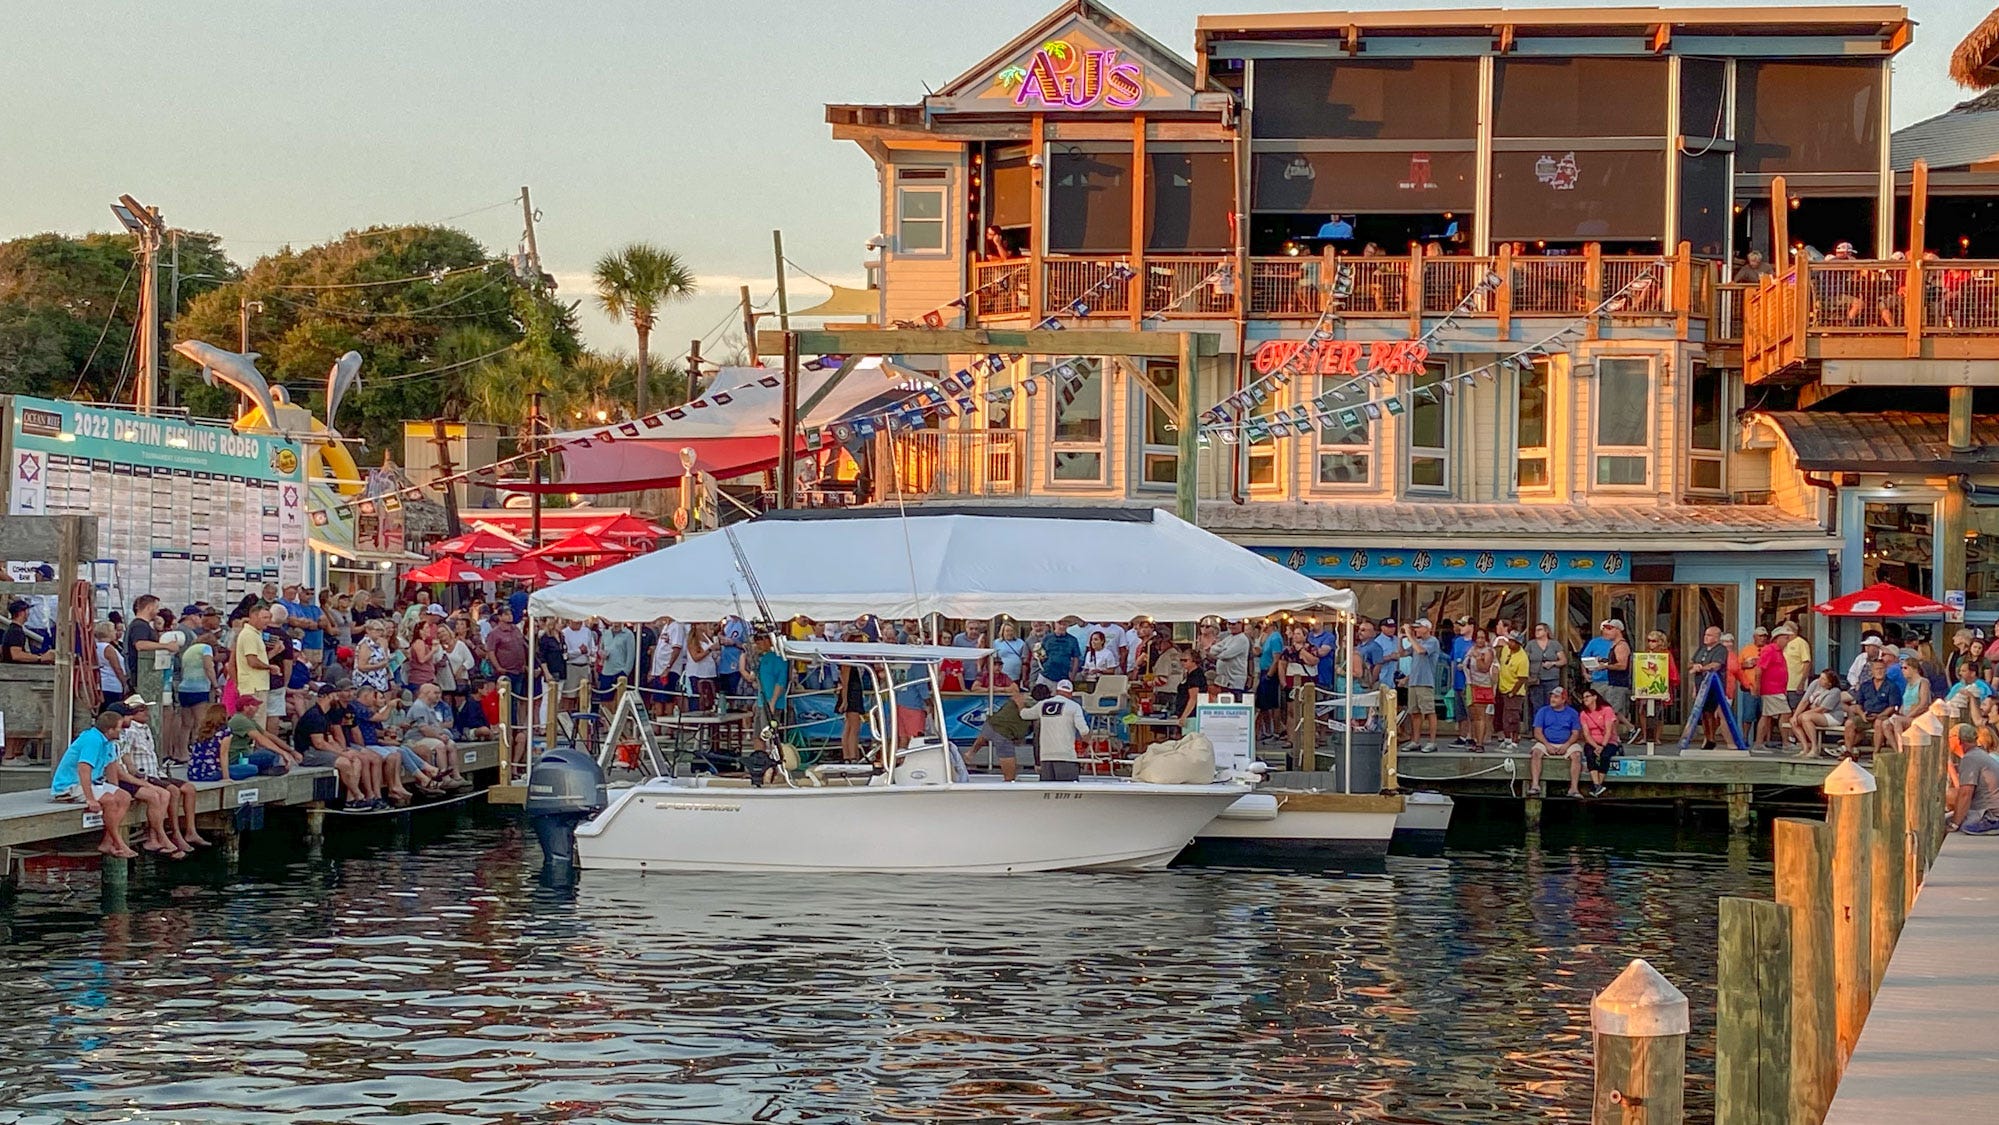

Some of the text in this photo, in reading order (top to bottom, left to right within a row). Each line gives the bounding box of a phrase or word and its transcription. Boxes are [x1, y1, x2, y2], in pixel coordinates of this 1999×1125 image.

[1016, 49, 1143, 108] AJ's
[1255, 340, 1428, 376] OYSTER BAR
[74, 412, 109, 440] 2022
[114, 418, 161, 447] DESTIN
[165, 426, 216, 453] FISHING
[220, 436, 259, 460] RODEO
